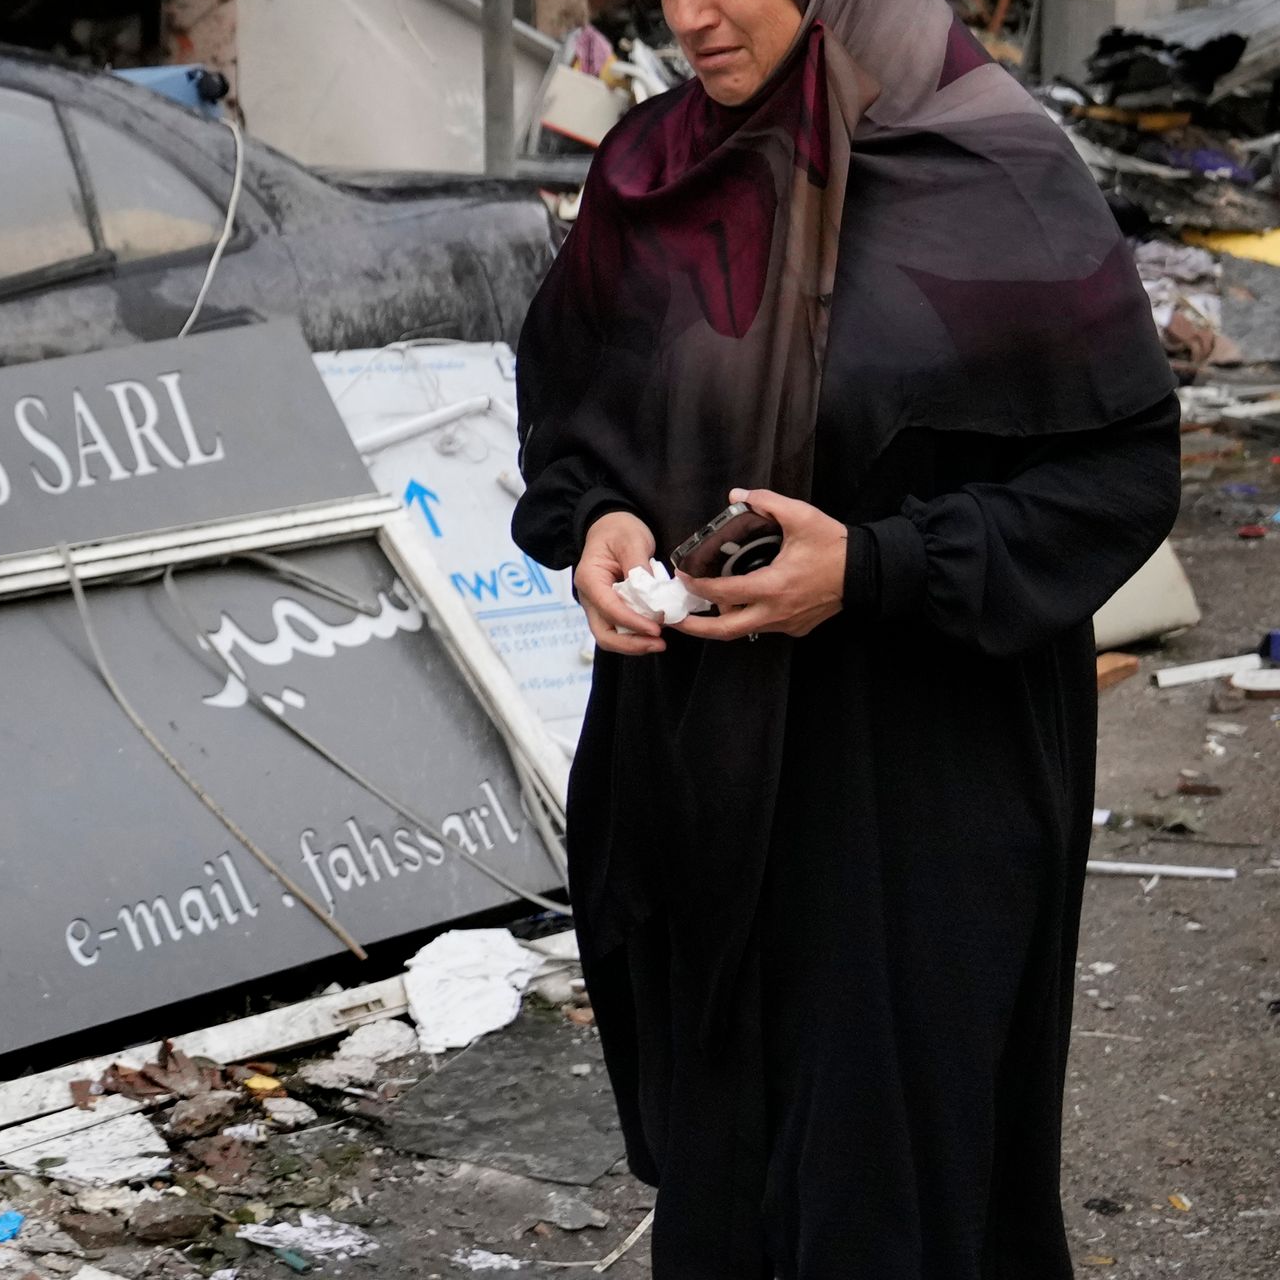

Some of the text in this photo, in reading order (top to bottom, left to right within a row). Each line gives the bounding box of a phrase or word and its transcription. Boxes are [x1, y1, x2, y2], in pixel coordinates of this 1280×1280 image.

[14, 373, 225, 495] SARL
[64, 851, 259, 967] e-mail
[300, 779, 519, 917] fahssarl
